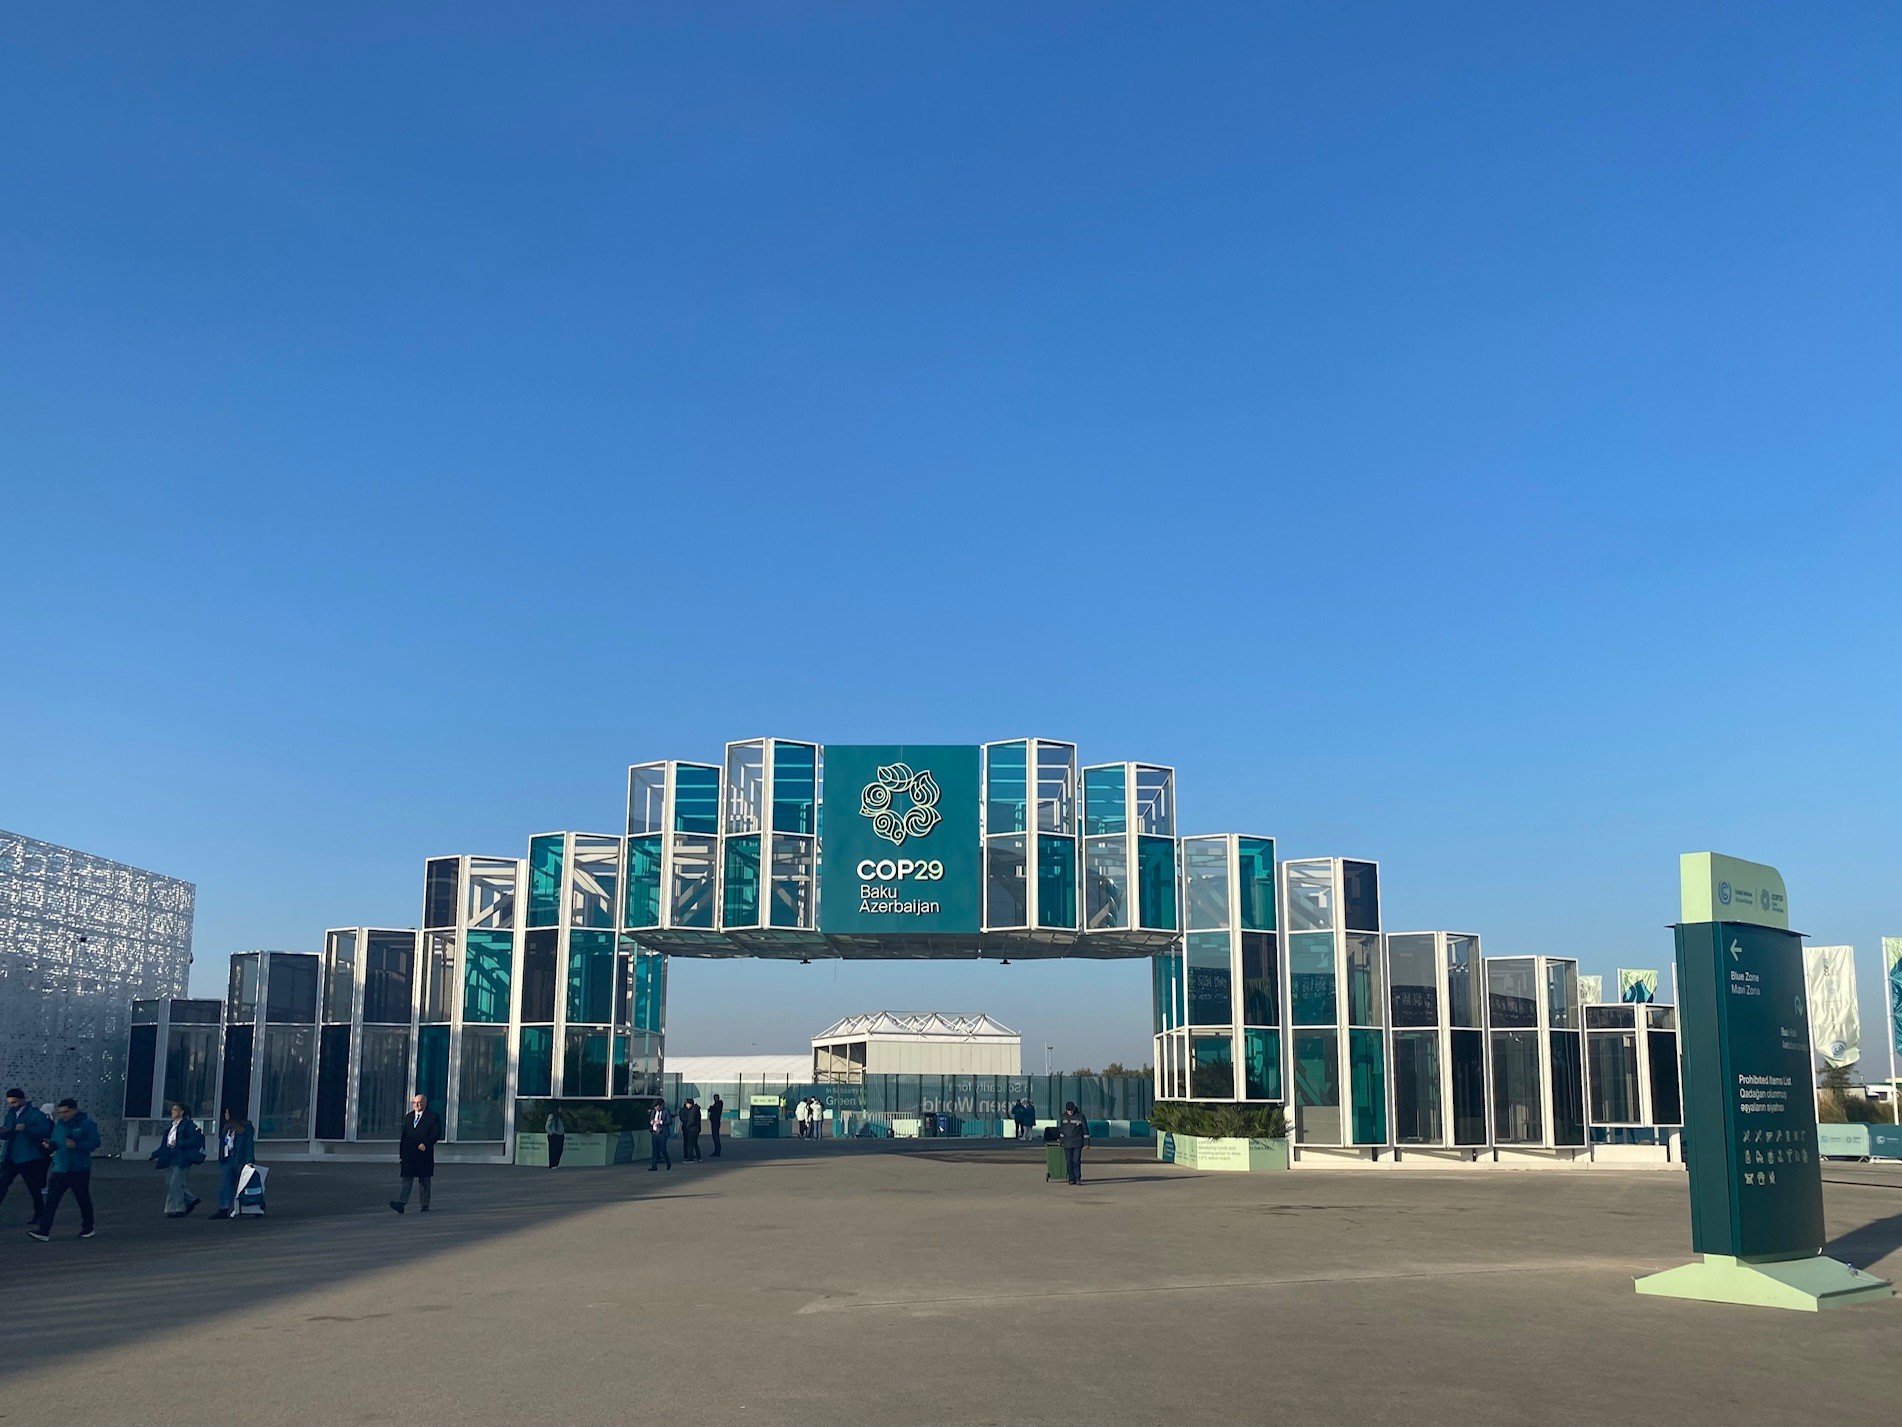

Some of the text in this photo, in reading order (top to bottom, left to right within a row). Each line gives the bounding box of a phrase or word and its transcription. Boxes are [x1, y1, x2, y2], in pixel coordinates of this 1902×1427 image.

[856, 859, 944, 880] COP29
[860, 884, 898, 899] Baku
[859, 899, 940, 916] Azerbaijan
[1730, 971, 1760, 983] Blue Zone
[1731, 984, 1761, 996] Mavi Zona
[1738, 1074, 1792, 1086] Prohibited Items List
[825, 1095, 856, 1106] Green
